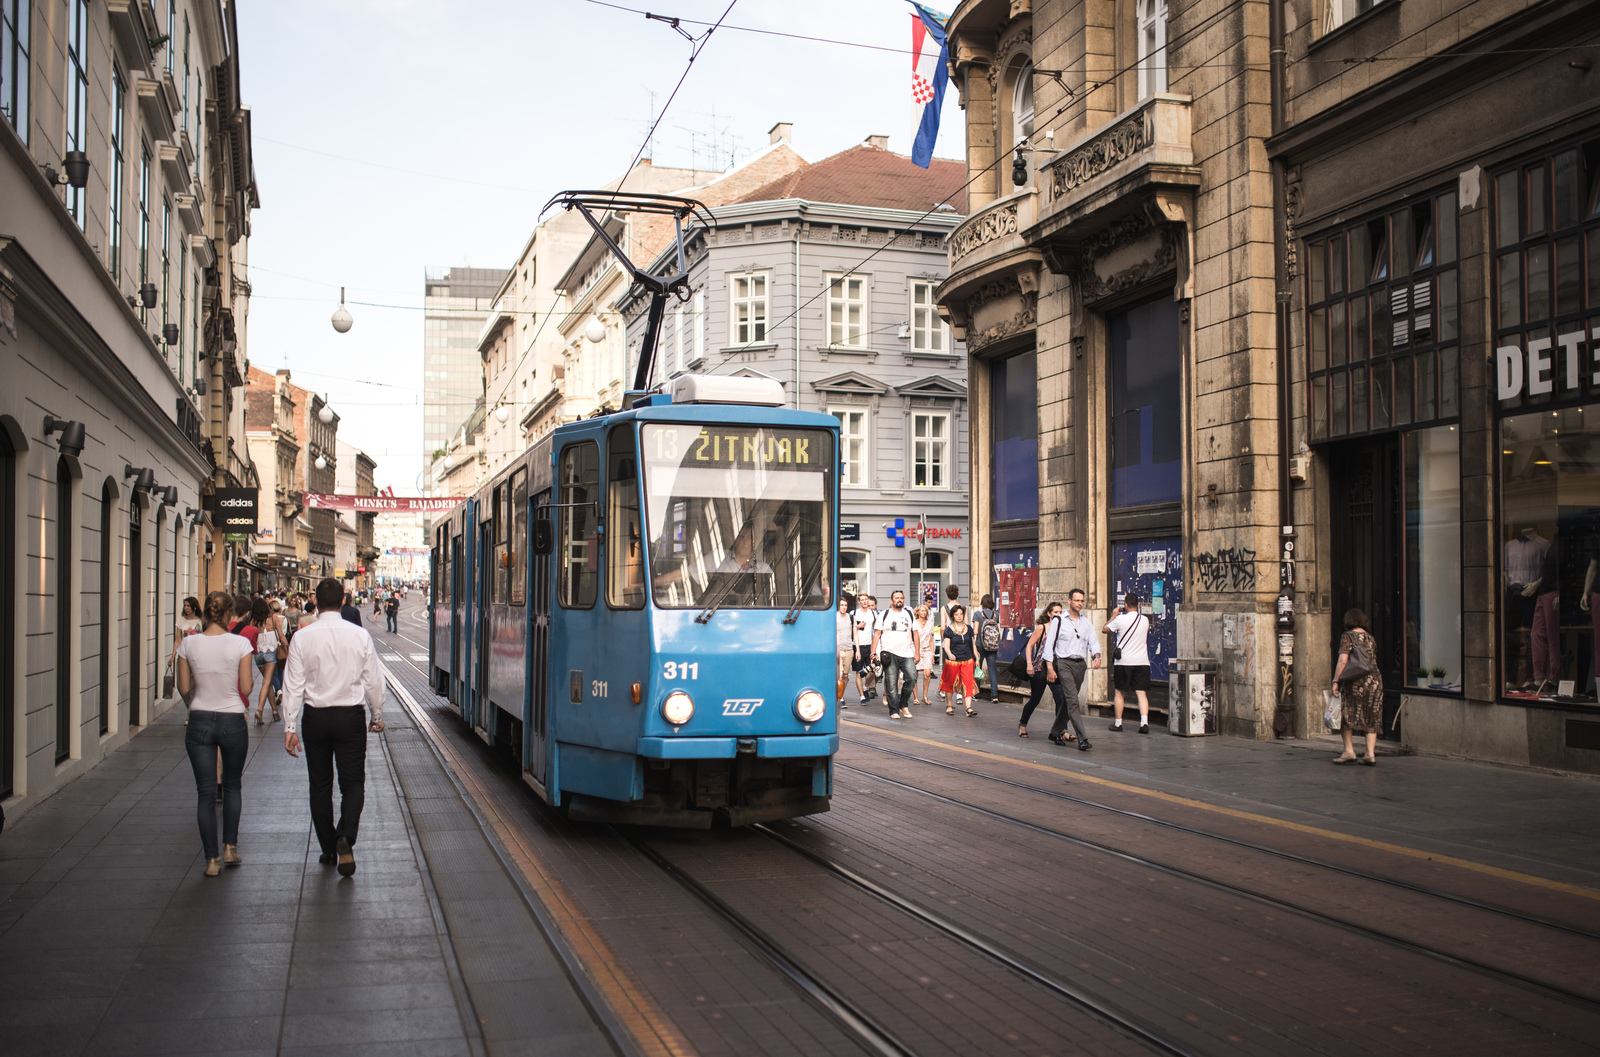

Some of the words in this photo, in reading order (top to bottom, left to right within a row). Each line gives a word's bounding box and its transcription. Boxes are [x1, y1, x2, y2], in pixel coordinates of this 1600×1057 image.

[653, 429, 679, 460] 13
[695, 430, 809, 464] ŽITNJAK
[221, 499, 253, 507] adidas
[353, 498, 397, 508] MINKUS
[902, 527, 961, 539] KETBANK
[663, 661, 699, 680] 311
[592, 680, 608, 698] 311
[722, 699, 764, 716] ZET
